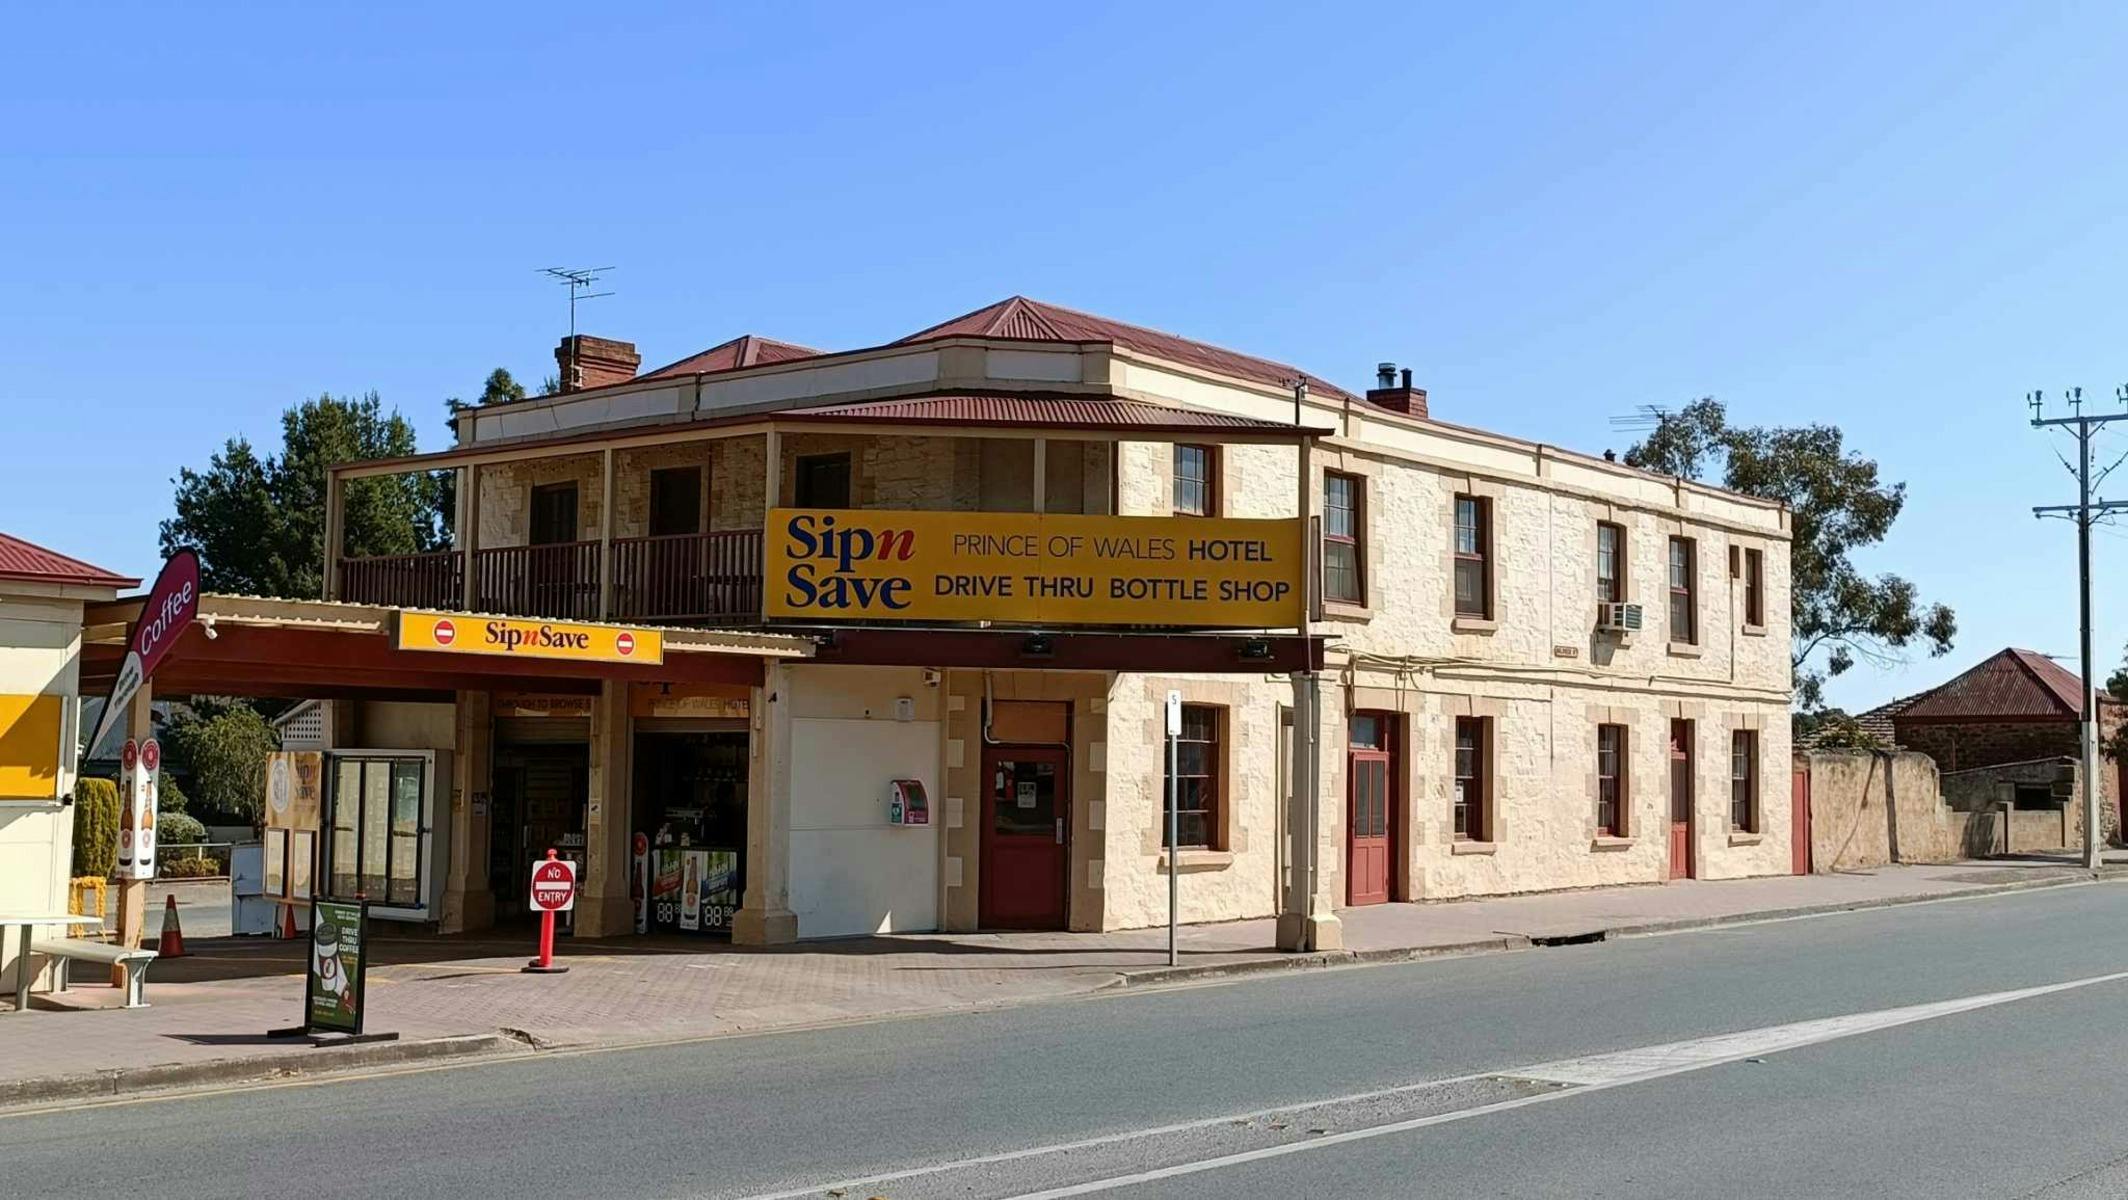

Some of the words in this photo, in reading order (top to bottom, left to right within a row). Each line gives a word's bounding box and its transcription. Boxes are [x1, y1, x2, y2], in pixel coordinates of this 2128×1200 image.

[953, 534, 1038, 557] PRINCE
[1048, 536, 1083, 558] OF
[1094, 537, 1175, 560] WALES
[1188, 540, 1272, 562] HOTEL
[786, 564, 912, 610] Save
[935, 575, 1012, 597] DRIVE
[1024, 576, 1093, 598] THRU
[1110, 578, 1207, 601] BOTTLE
[1219, 580, 1290, 602] SHOP
[141, 581, 192, 656] Coffee
[547, 868, 561, 879] NO
[538, 891, 567, 903] ENTRY
[341, 926, 358, 936] DRIVE
[342, 936, 357, 945] THRU
